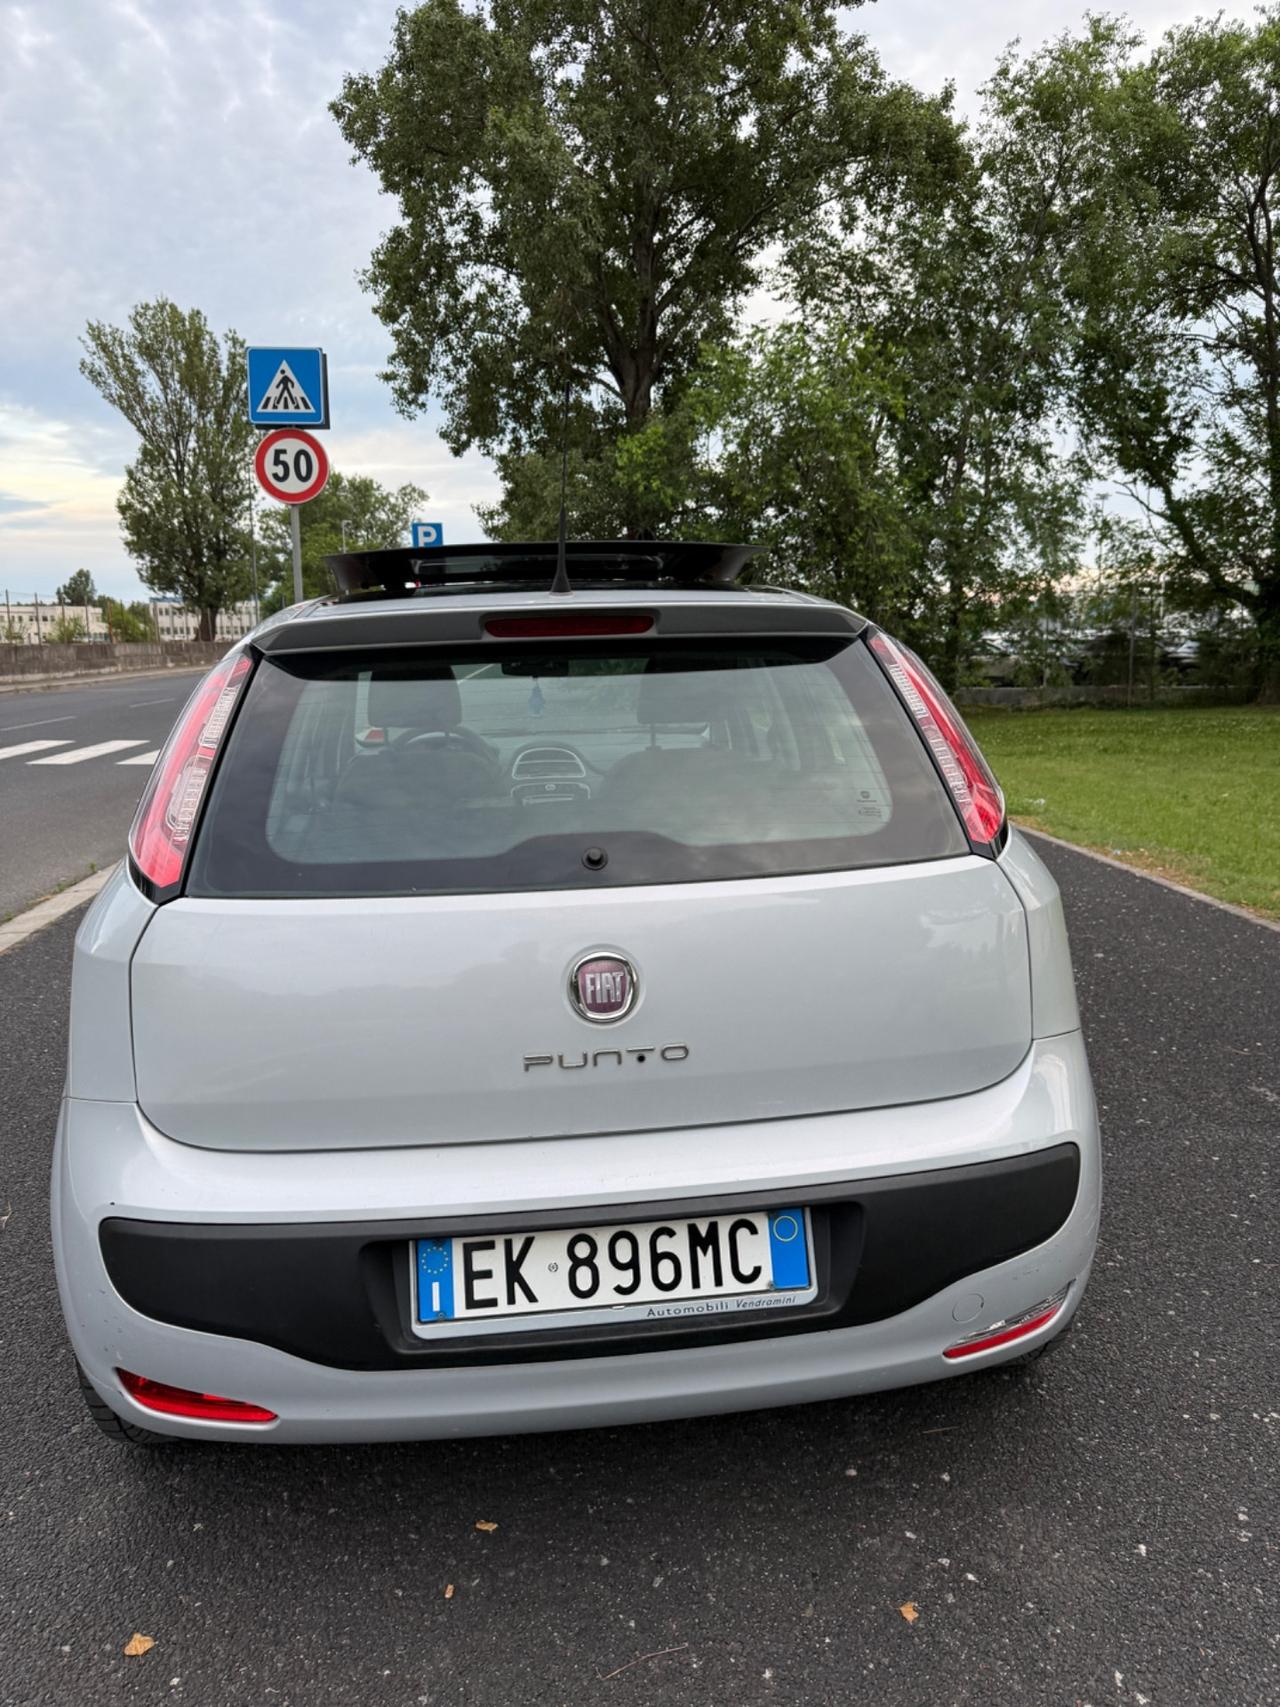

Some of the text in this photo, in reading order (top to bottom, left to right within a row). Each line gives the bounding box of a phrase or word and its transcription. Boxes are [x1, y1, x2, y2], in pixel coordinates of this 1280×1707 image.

[272, 449, 313, 483] 50
[417, 526, 437, 547] P
[584, 971, 625, 1004] FIAT
[462, 1235, 539, 1310] EK
[646, 1295, 797, 1318] Automobili Vendramini
